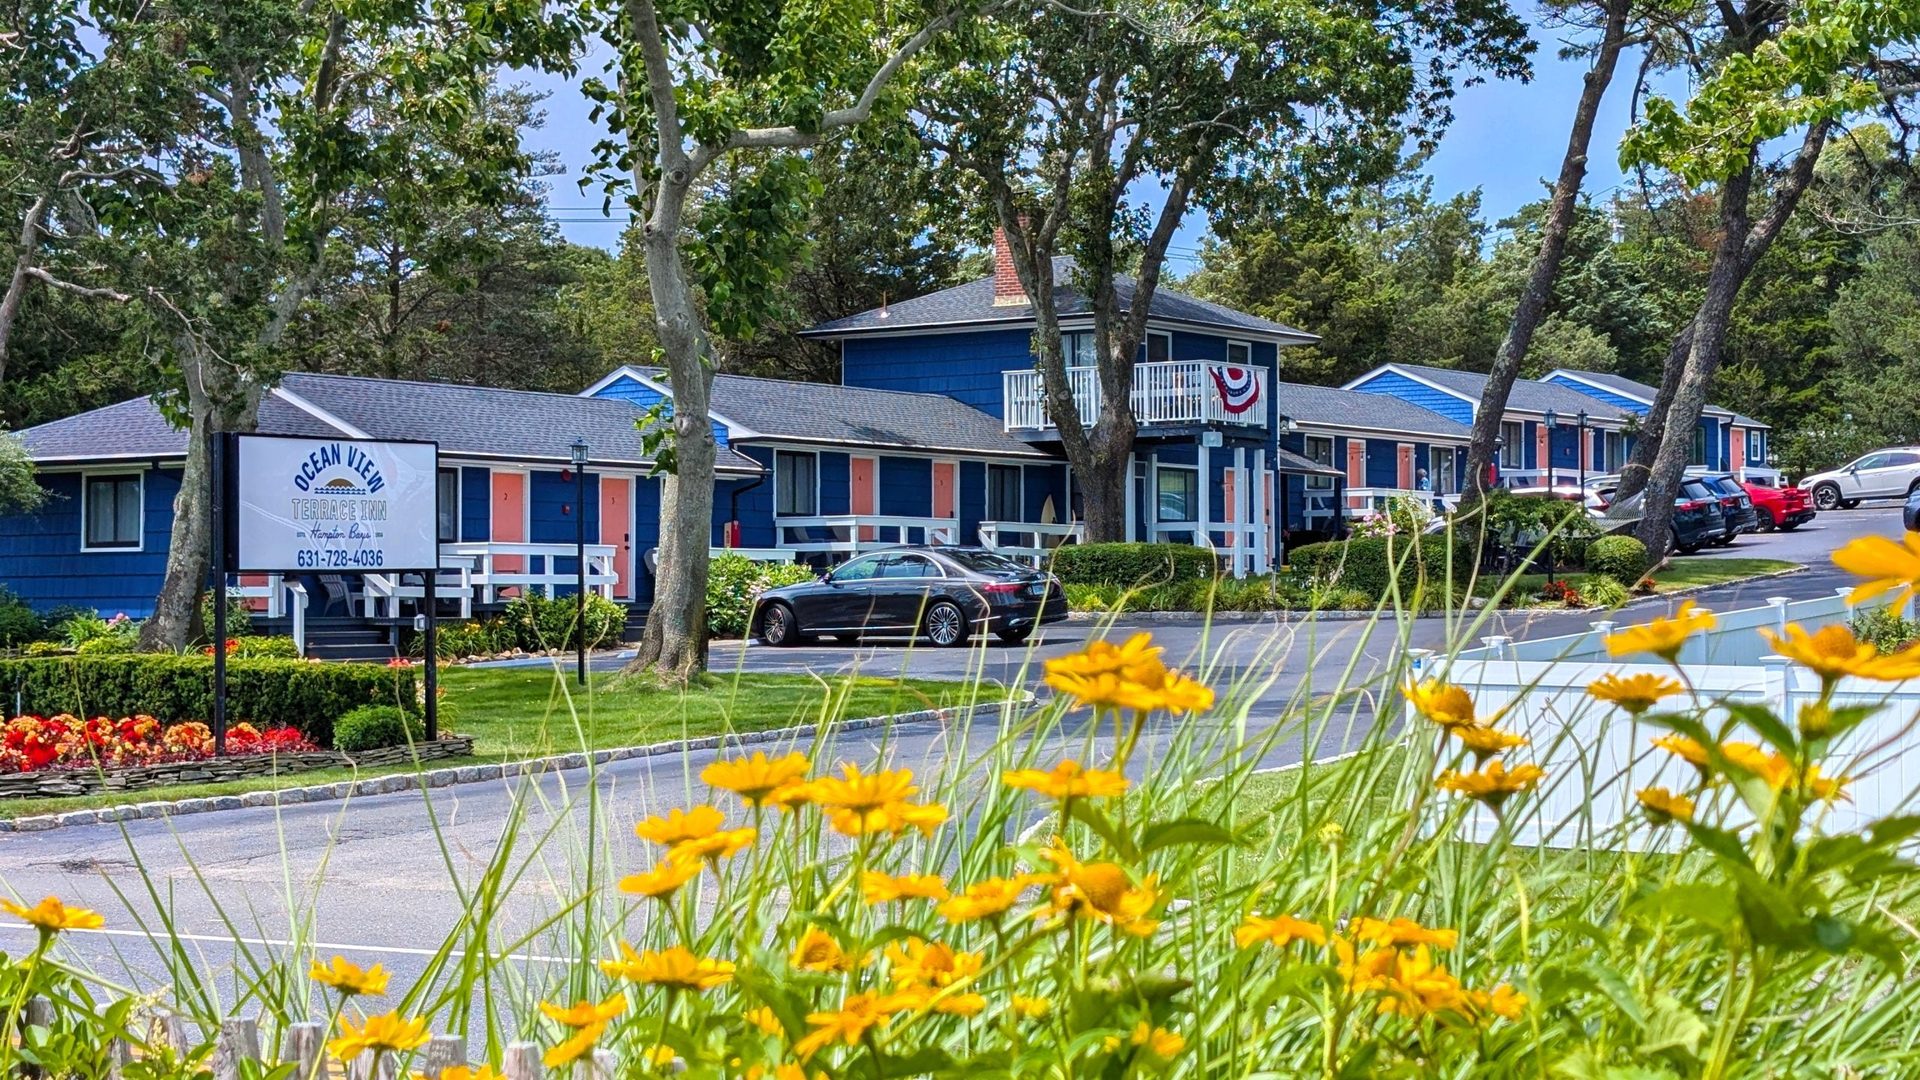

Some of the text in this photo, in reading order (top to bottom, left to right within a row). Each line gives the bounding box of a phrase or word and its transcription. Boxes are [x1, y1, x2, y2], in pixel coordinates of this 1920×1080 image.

[294, 443, 385, 494] OCEAN VIEW
[292, 499, 387, 521] TERRACE INN
[310, 521, 371, 548] Hampton Bays
[297, 550, 383, 567] 631-728-4036
